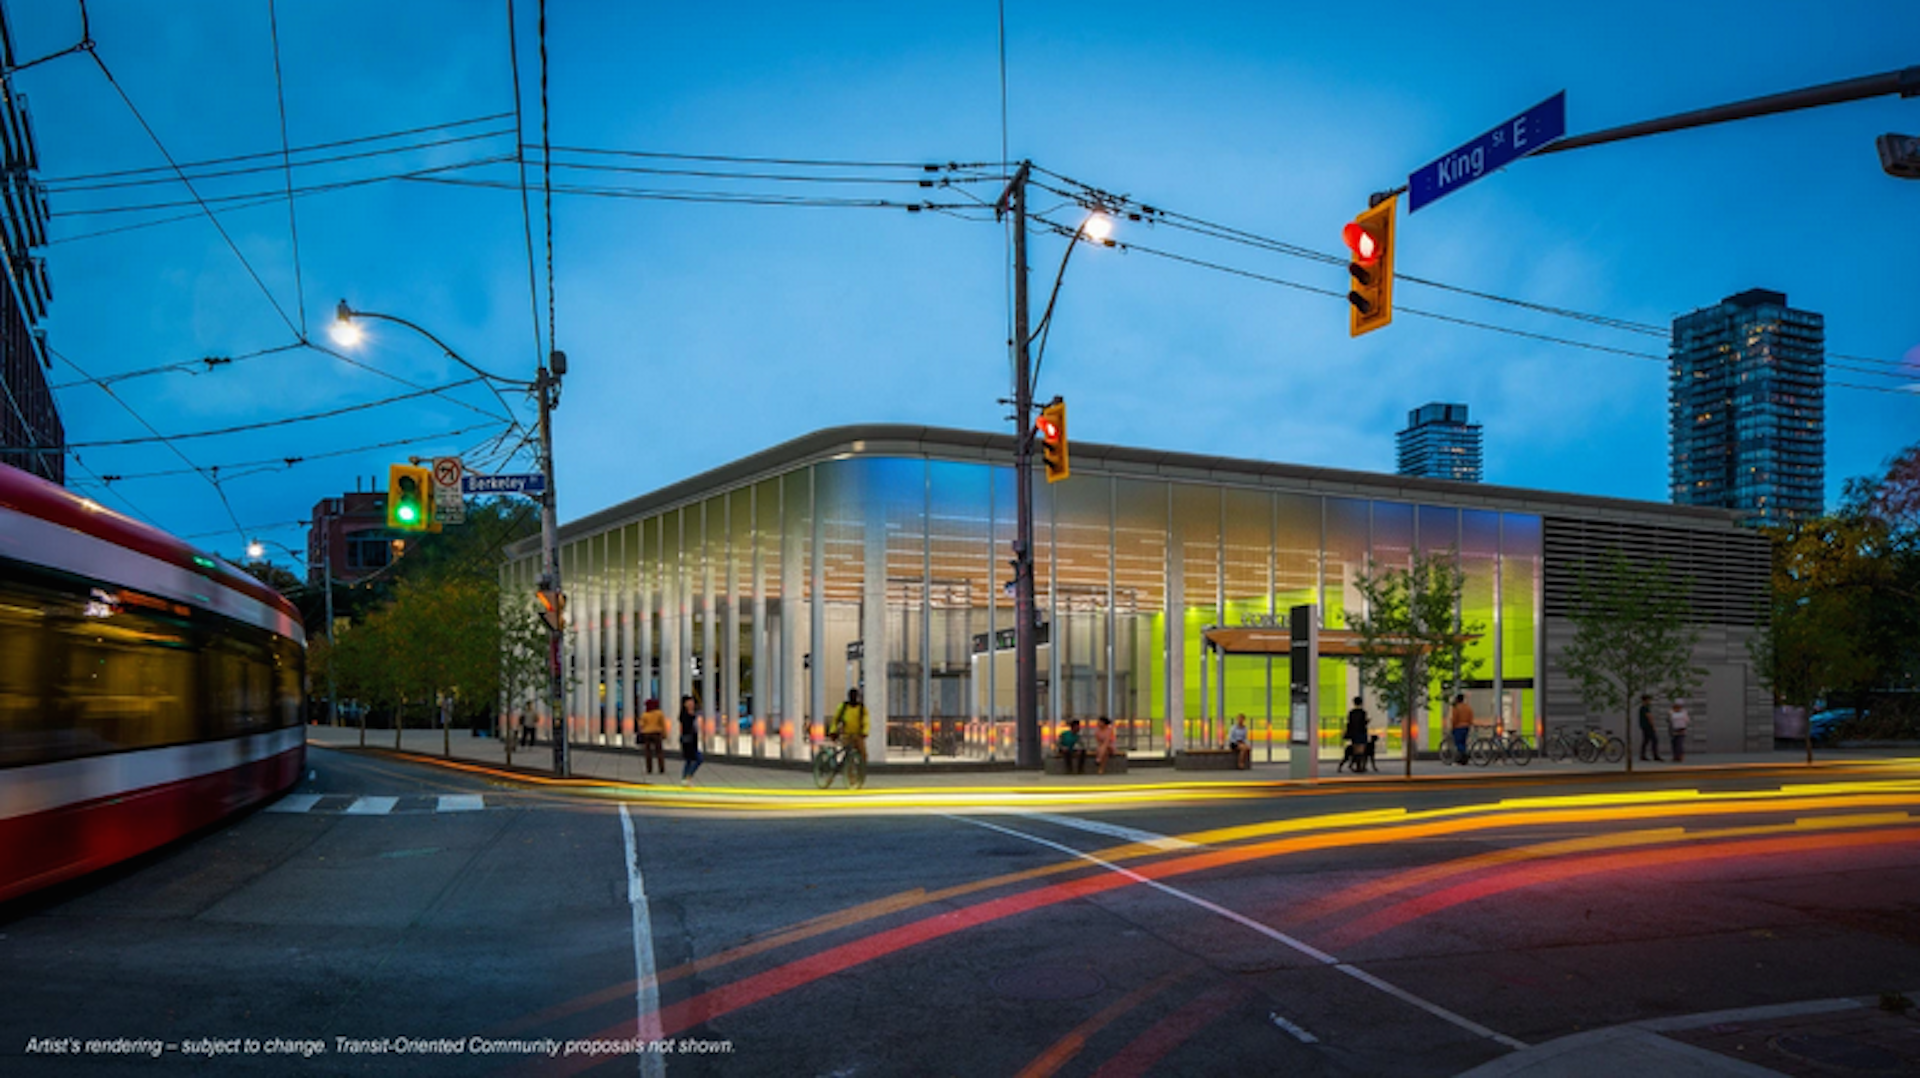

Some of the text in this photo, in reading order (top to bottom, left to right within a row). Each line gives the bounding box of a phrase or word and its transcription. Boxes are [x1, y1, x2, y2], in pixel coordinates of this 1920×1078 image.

[1438, 116, 1528, 188] King St E
[469, 477, 526, 491] Berkeley
